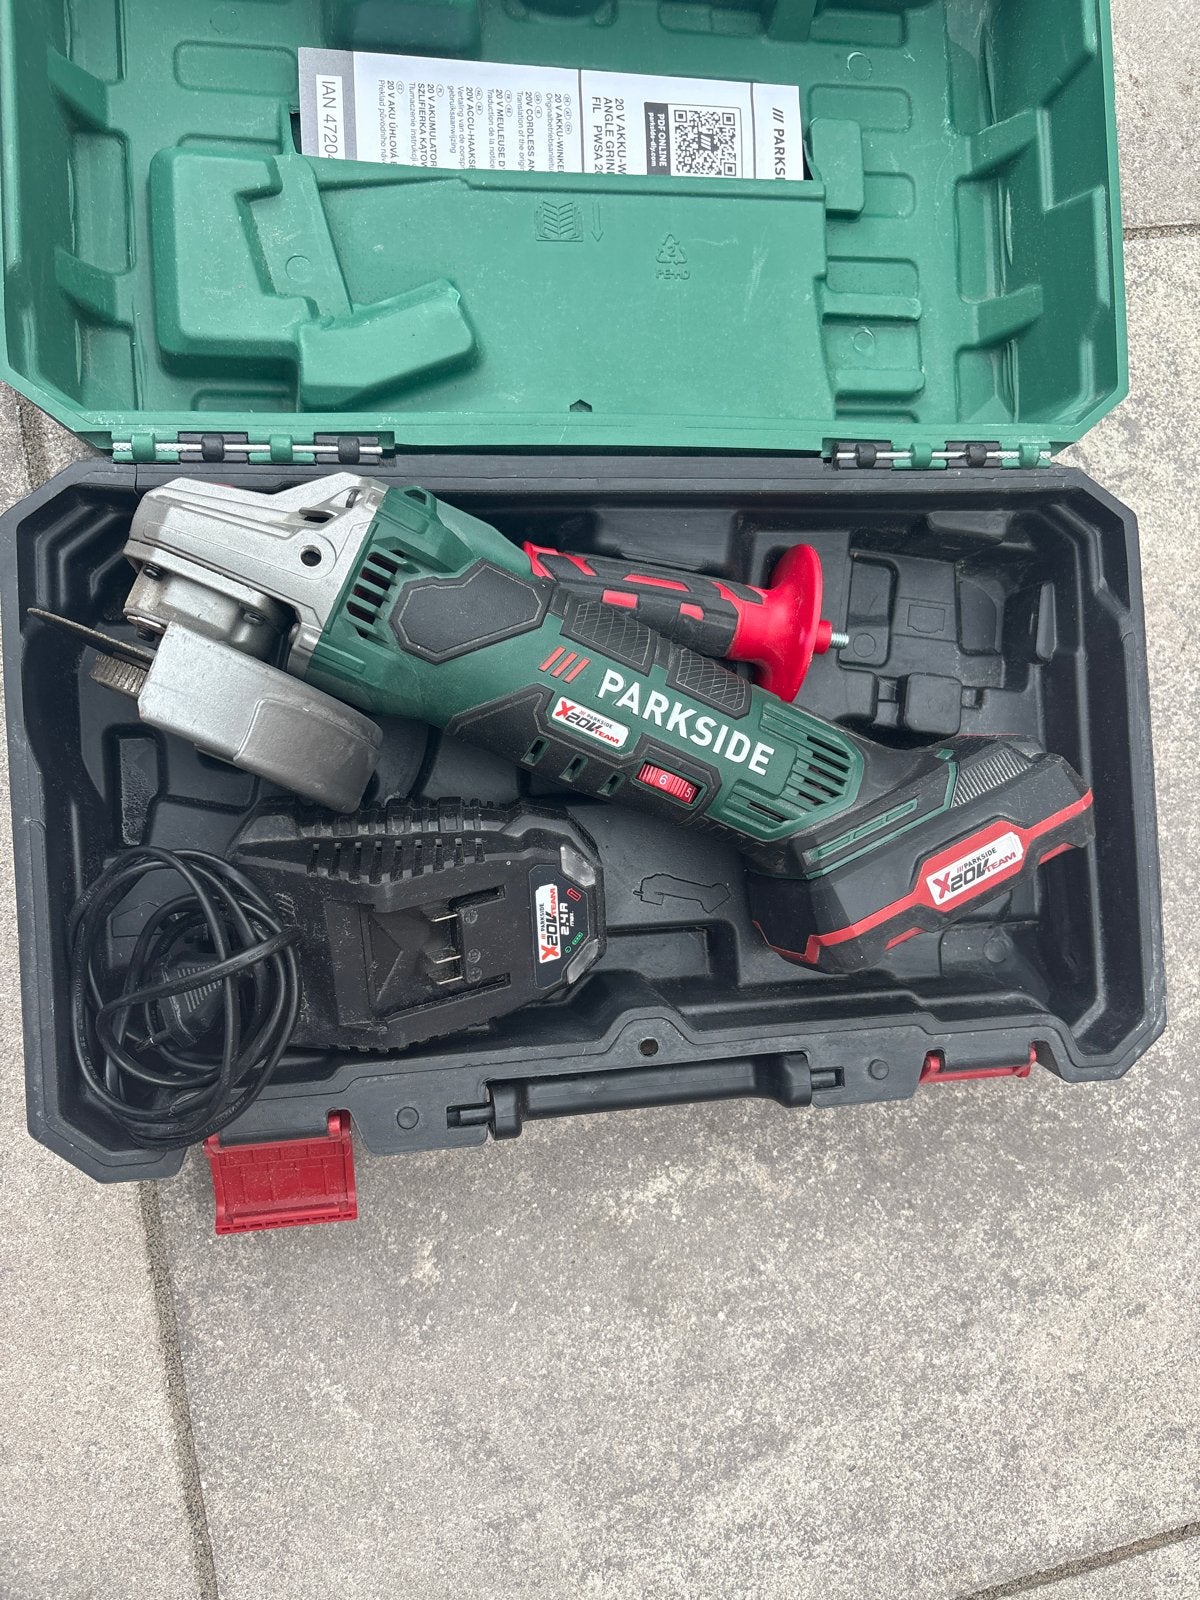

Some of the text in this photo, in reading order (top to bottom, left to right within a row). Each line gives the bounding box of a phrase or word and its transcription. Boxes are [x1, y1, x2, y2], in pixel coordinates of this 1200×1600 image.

[322, 81, 336, 109] IAN
[378, 80, 386, 106] Překlad
[387, 81, 394, 90] 20
[428, 84, 434, 93] 20
[496, 89, 503, 99] 20
[525, 92, 533, 106] 20V
[555, 94, 562, 103] 20
[418, 83, 426, 134] SZLIFIERKA
[457, 86, 465, 117] Vertaling
[592, 97, 601, 113] FIL
[378, 108, 387, 146] původního
[447, 86, 457, 153] gebruiksaanwijzing
[489, 127, 496, 136] de
[497, 109, 505, 158] MEULEUSE
[526, 109, 534, 156] CORDLESS
[546, 93, 554, 171] Originalbetriebsanleitu
[389, 122, 399, 158] ÚHLOVÁ
[459, 134, 465, 143] de
[556, 113, 564, 172] AKKU-WINKE
[594, 126, 602, 160] PWSA
[604, 97, 615, 174] ANGLE GRIN
[615, 98, 626, 174] 20 V AKKU-W
[648, 112, 657, 166] parkside-diy.com
[657, 113, 667, 166] PDF ONLINE
[490, 147, 498, 168] notice
[586, 713, 614, 729] PARKSIDE
[597, 668, 776, 776] PARKSIDE
[659, 774, 669, 785] 6
[685, 787, 692, 798] 5
[964, 847, 997, 869] PARKSIDE
